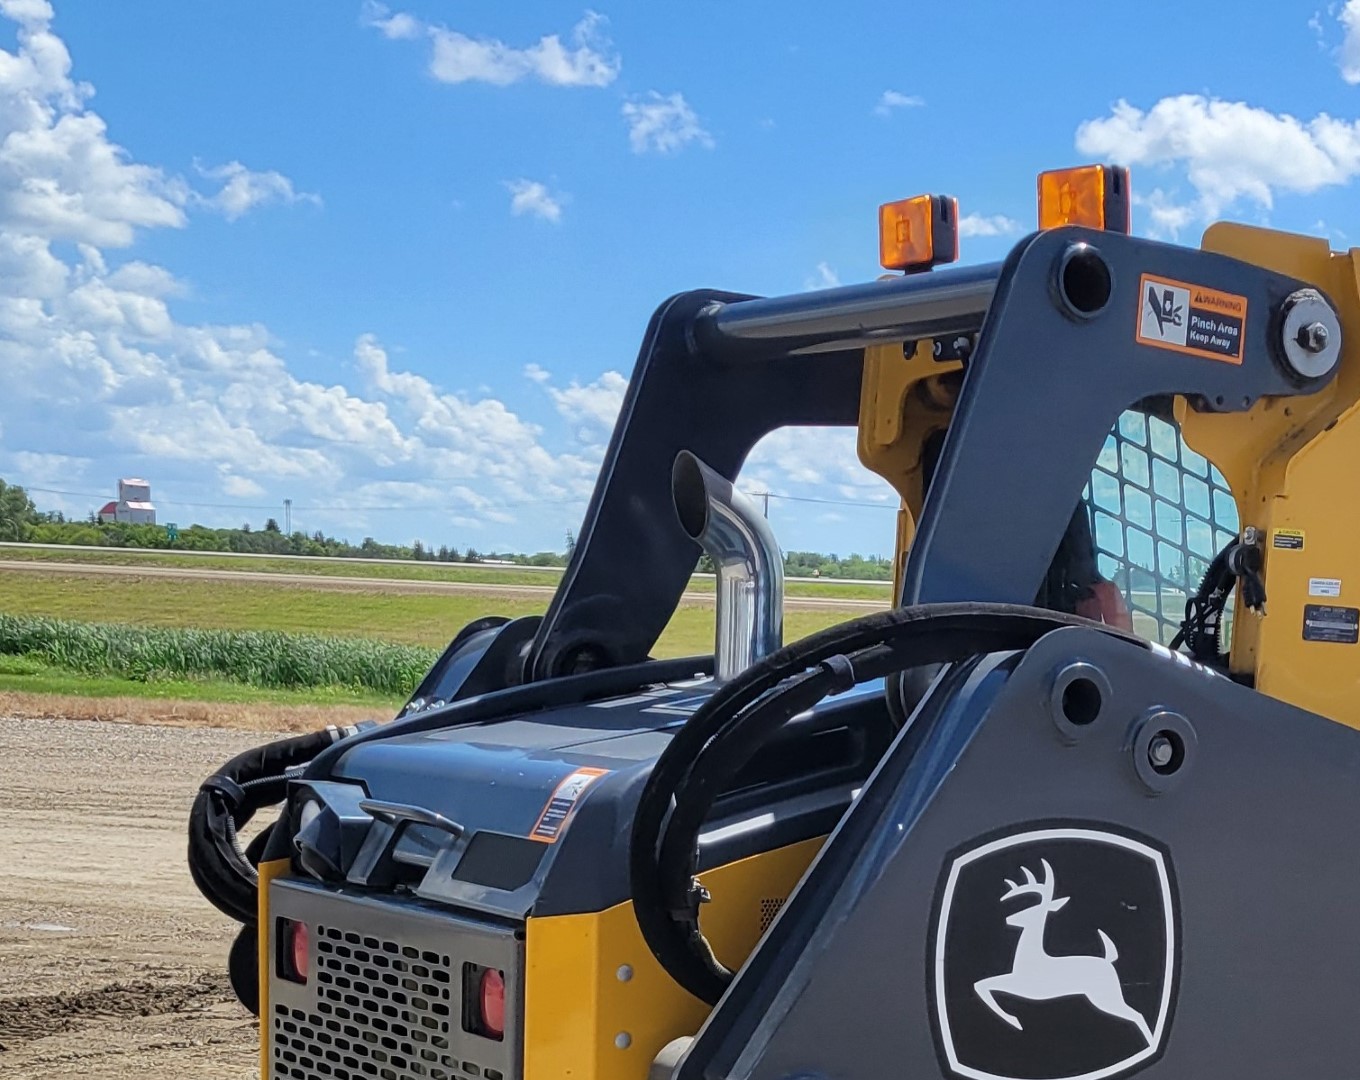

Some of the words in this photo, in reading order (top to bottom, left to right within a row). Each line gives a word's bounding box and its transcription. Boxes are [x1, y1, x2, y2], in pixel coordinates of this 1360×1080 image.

[1203, 296, 1241, 312] WARNING
[1192, 316, 1216, 331] Pinch
[1218, 322, 1238, 336] Area
[1190, 330, 1209, 344] Keep
[1210, 335, 1231, 349] Away
